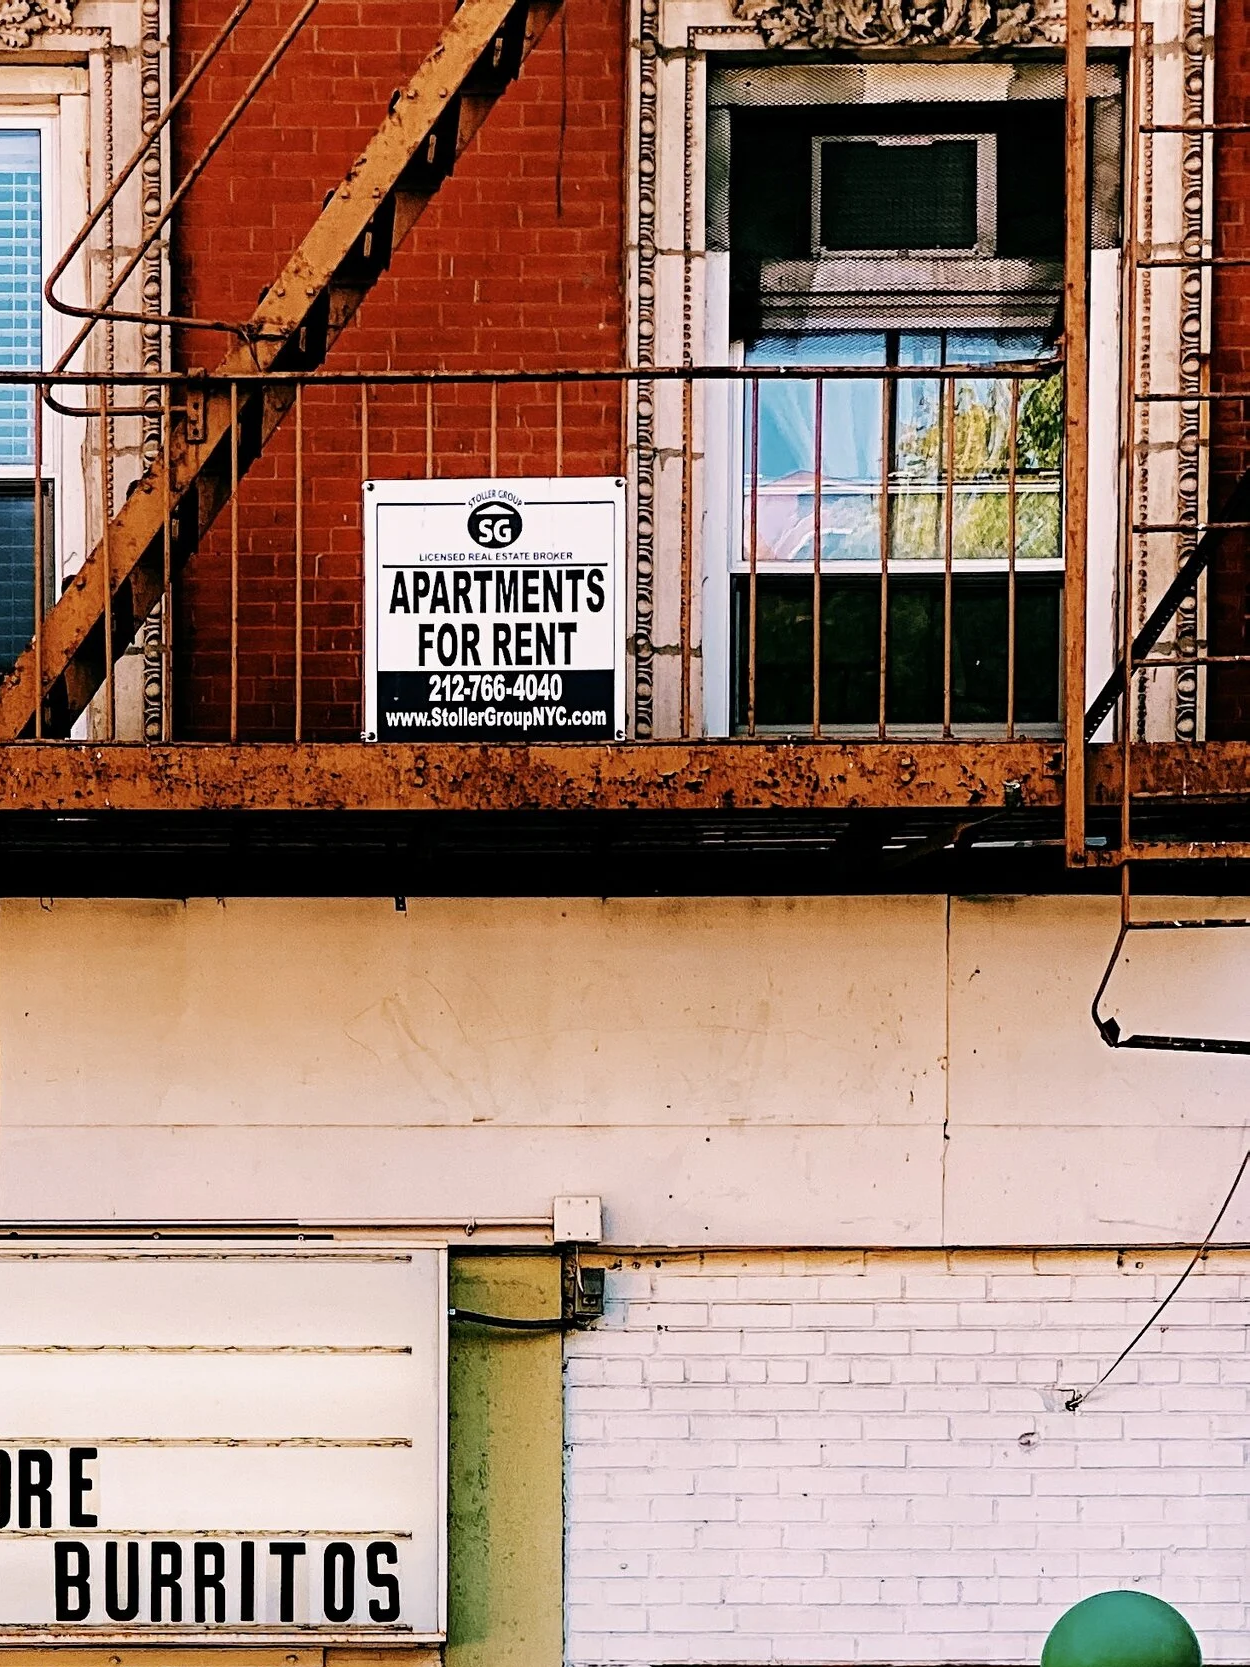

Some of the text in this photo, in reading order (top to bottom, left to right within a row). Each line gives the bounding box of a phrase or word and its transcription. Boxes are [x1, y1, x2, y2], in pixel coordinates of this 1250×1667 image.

[468, 489, 523, 508] STOLLER GROUP
[478, 519, 512, 543] SG
[419, 551, 573, 562] LICENSED REAL ESTATE BROKER
[389, 568, 605, 614] APARTMENTS
[418, 622, 578, 667] FOR RENT
[428, 673, 563, 702] 212-766-4040
[386, 706, 607, 731] www.StollerGroupNYC.com
[54, 1540, 401, 1624] BURRITOS
